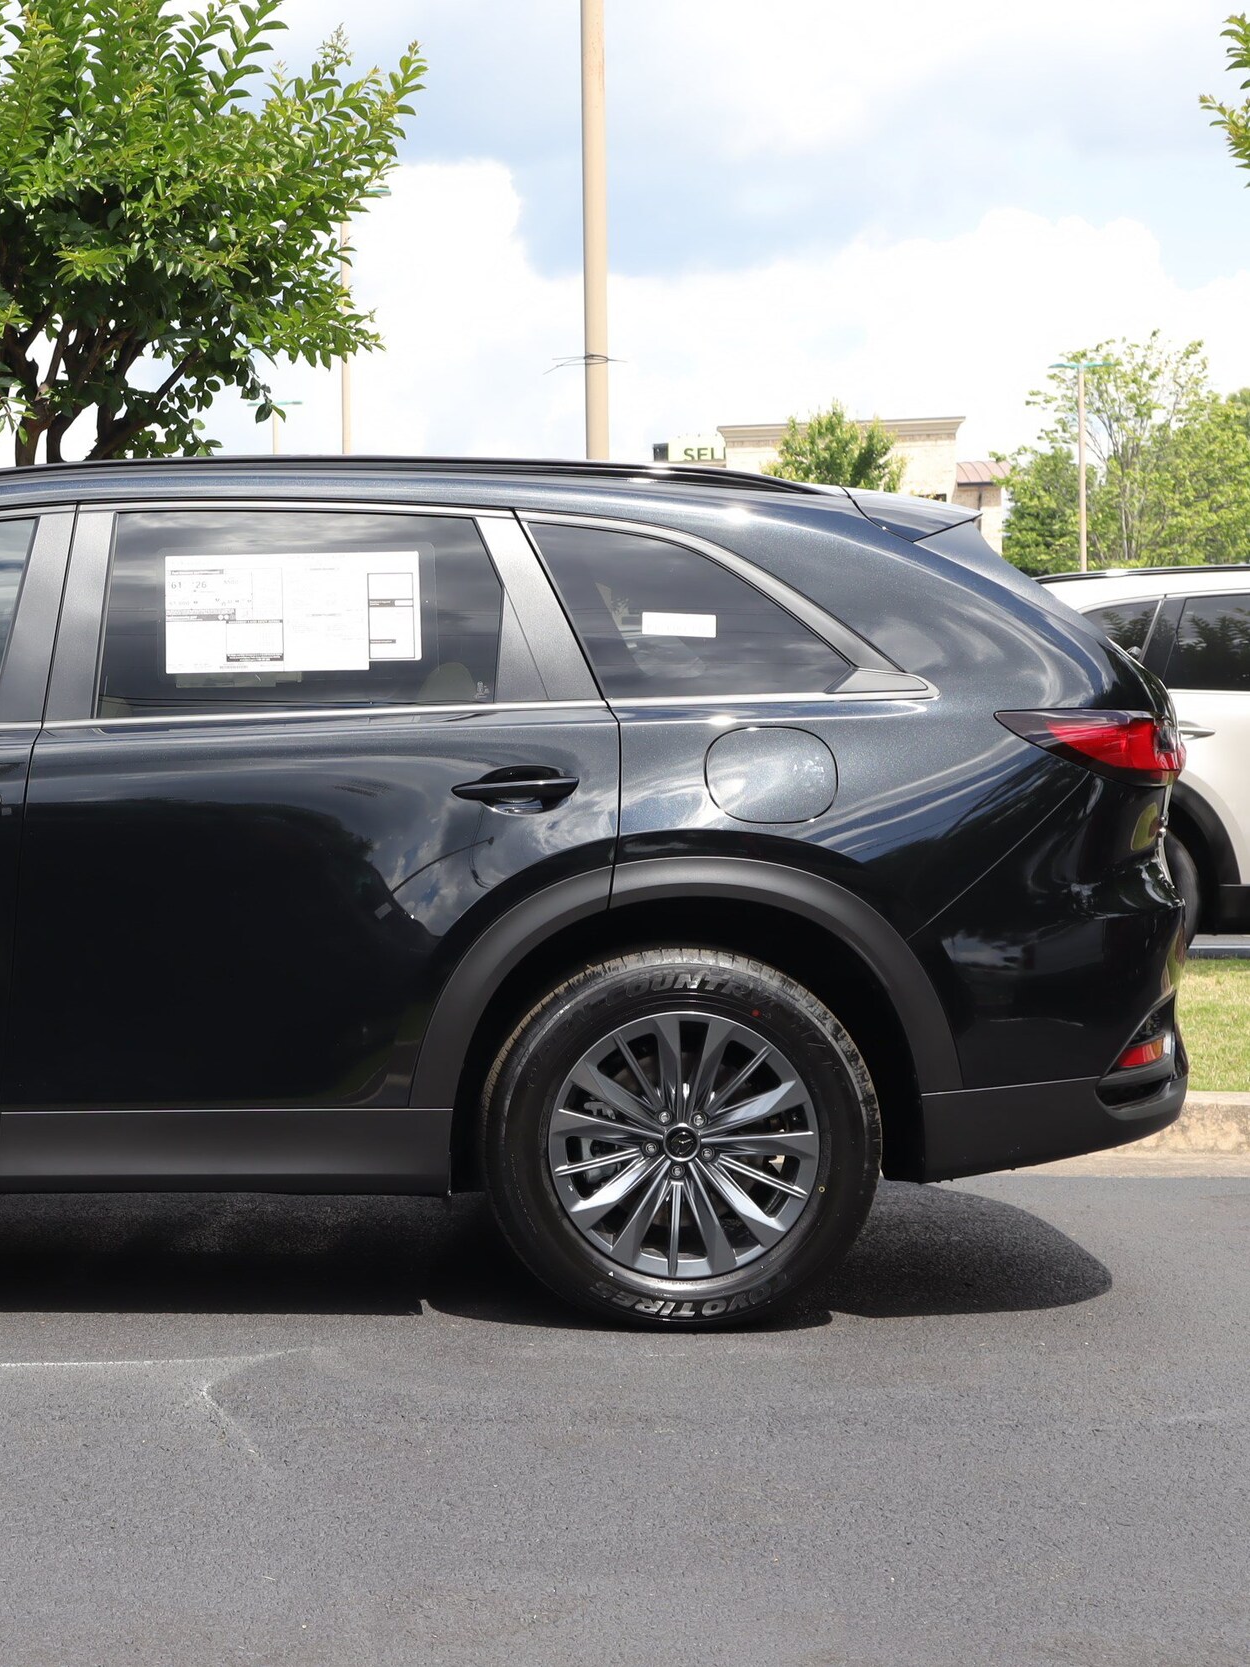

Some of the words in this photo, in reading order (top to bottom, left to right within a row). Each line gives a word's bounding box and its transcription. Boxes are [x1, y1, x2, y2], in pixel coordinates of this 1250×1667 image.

[683, 447, 726, 461] SEL
[588, 1280, 697, 1318] TIRES
[701, 1271, 792, 1317] TOYO
